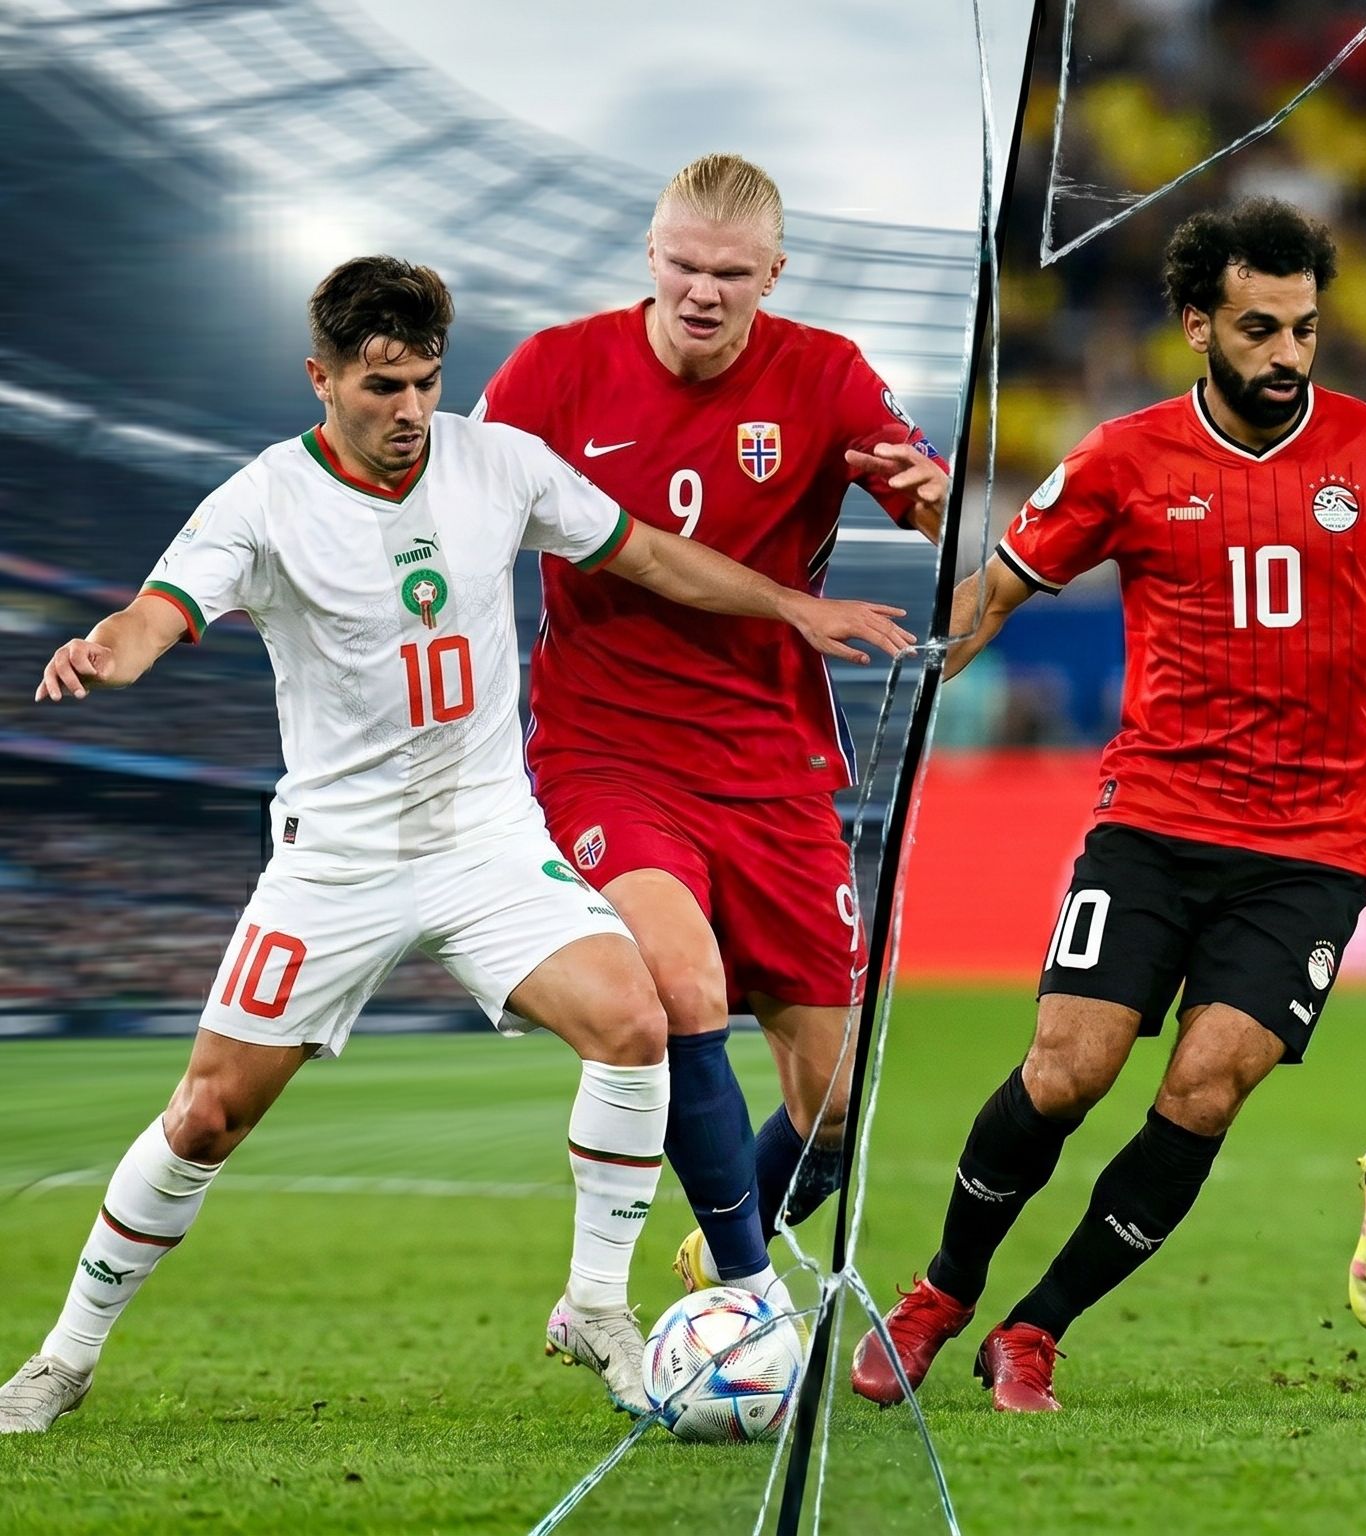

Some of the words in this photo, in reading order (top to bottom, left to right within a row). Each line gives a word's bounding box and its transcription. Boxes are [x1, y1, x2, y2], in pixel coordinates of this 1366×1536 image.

[668, 468, 703, 539] 9
[1167, 507, 1205, 521] PUMA
[1227, 544, 1302, 628] 10
[400, 633, 475, 728] 10
[836, 883, 860, 953] 9
[1044, 889, 1111, 972] 10
[220, 923, 307, 1019] 10
